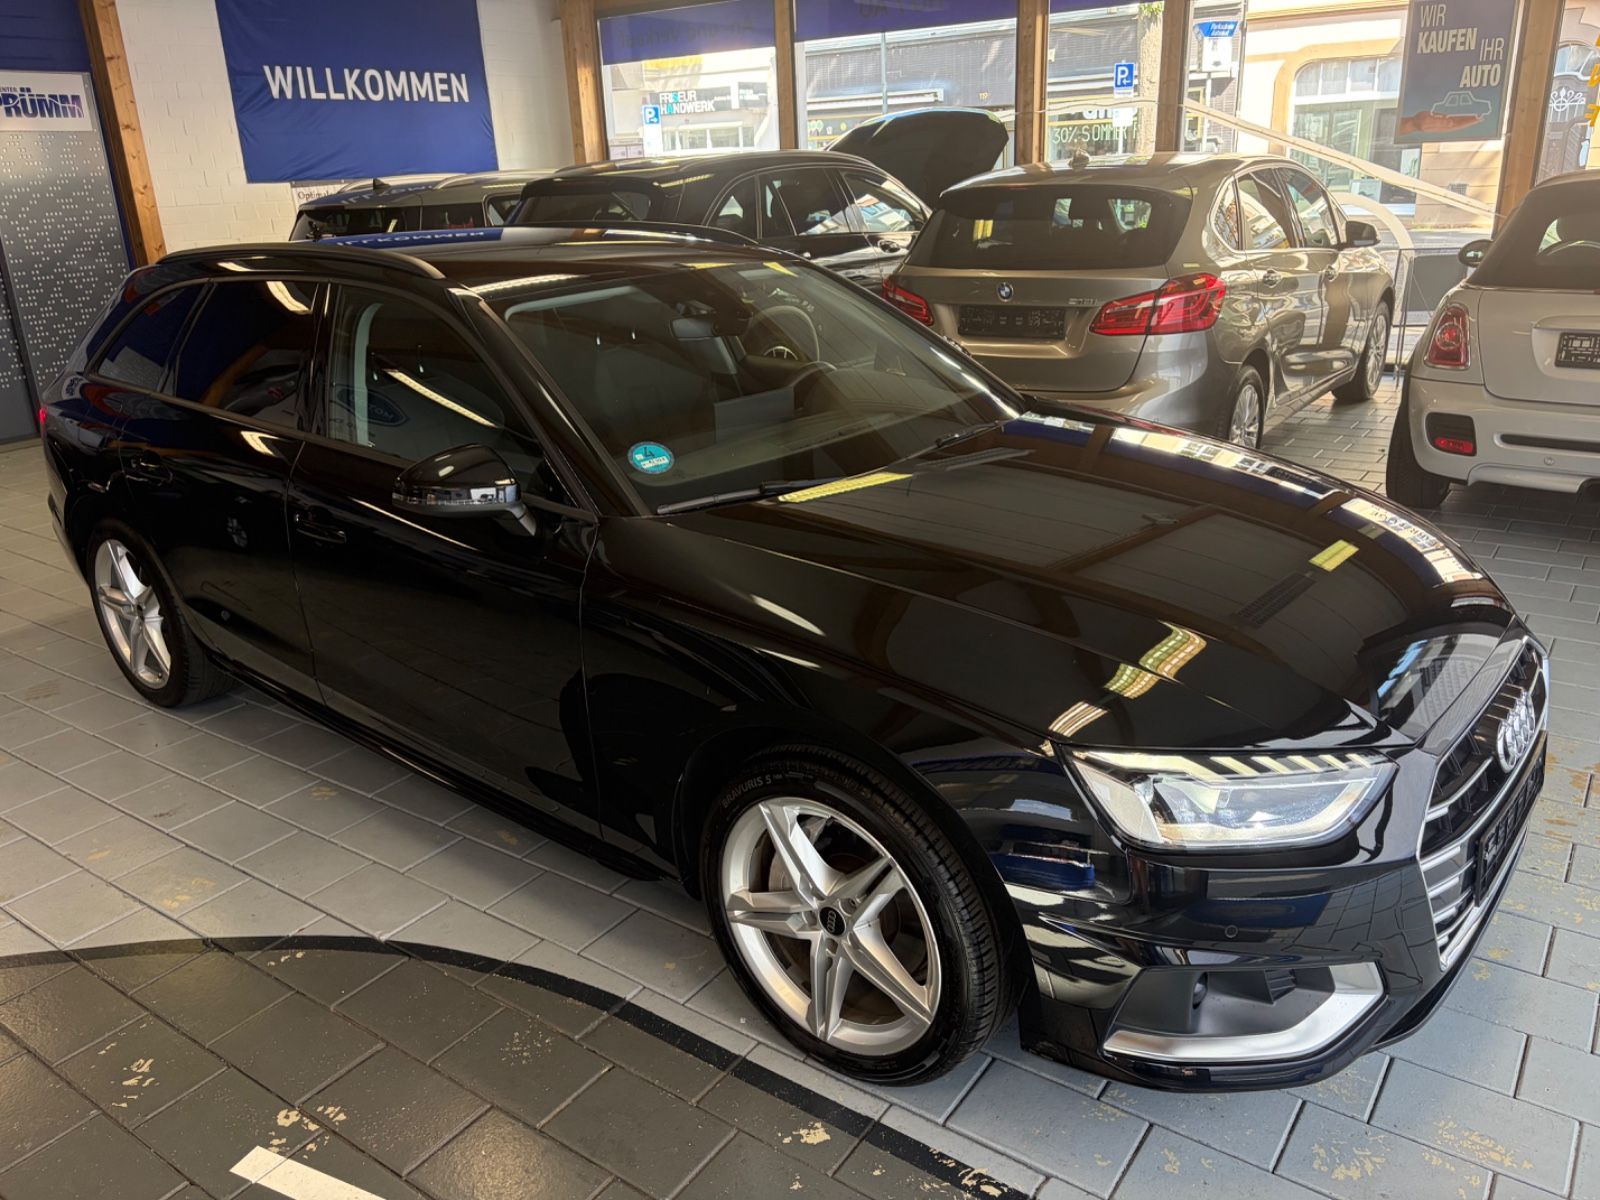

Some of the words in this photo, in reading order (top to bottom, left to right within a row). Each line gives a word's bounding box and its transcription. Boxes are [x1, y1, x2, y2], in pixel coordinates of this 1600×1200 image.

[1420, 4, 1446, 28] WIR
[1417, 28, 1478, 54] KAUFEN
[1480, 37, 1505, 62] IHR
[263, 65, 470, 102] WILLKOMMEN
[1460, 64, 1501, 88] AUTO
[0, 86, 85, 119] RÜMM
[660, 100, 716, 116] HANDWERK
[1052, 126, 1078, 144] 30%
